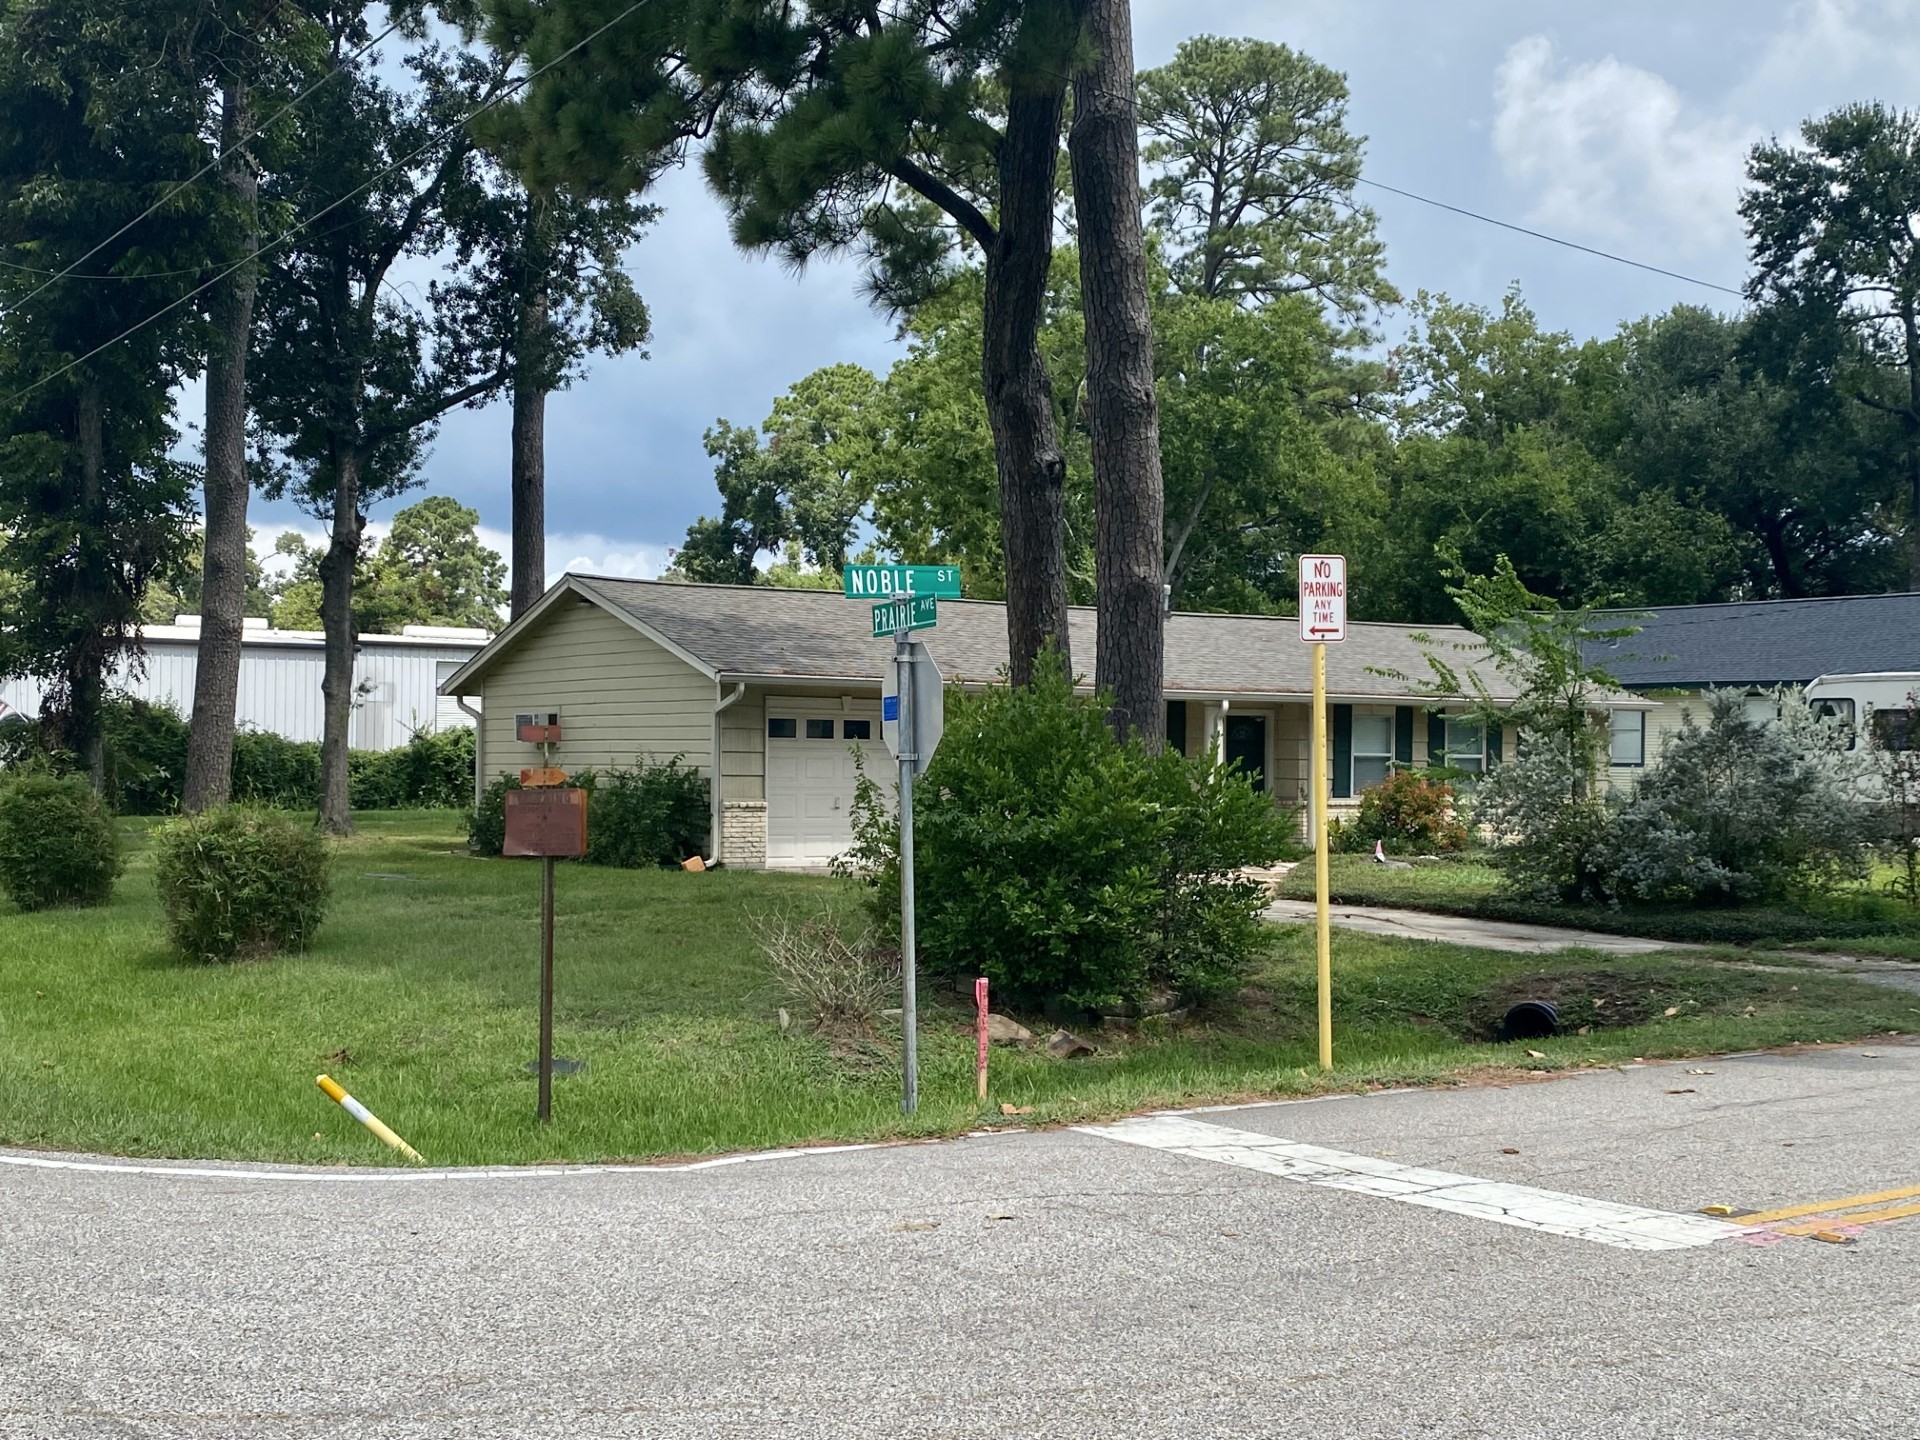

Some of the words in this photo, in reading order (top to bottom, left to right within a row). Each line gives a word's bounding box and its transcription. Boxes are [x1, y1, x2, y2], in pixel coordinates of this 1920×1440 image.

[1314, 562, 1331, 578] NO
[852, 569, 916, 595] NOBLE
[937, 570, 953, 582] ST
[1303, 581, 1343, 598] PARKING
[1314, 600, 1332, 610] ANY
[874, 602, 917, 633] PRAIRIE
[920, 597, 935, 612] AVE
[1313, 612, 1335, 623] TIME
